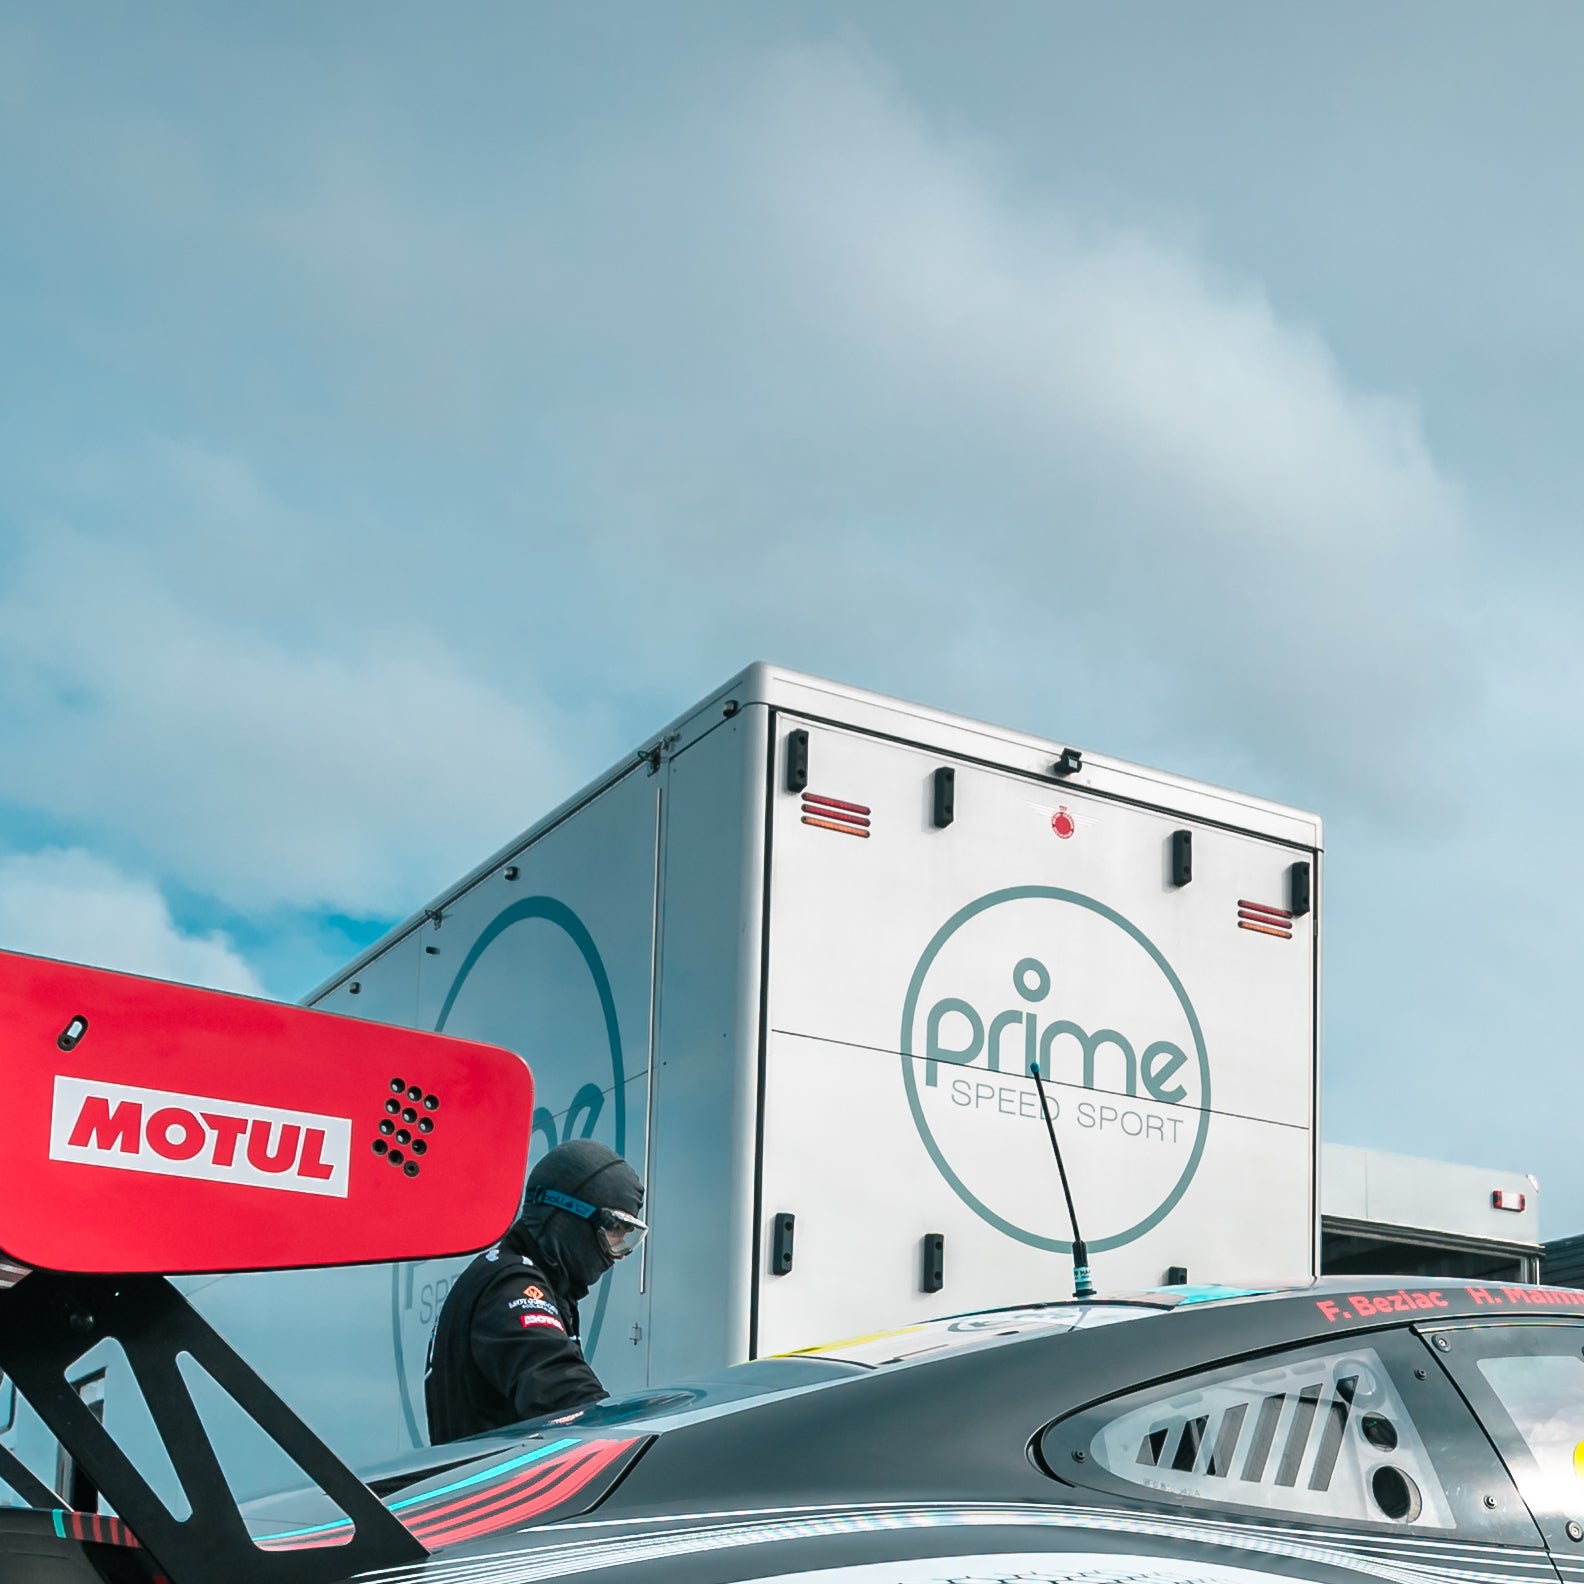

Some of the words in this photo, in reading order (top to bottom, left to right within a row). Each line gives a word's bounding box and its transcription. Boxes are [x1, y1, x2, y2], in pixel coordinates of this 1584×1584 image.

[925, 957, 1188, 1104] prime
[67, 1095, 335, 1180] MOTUL
[951, 1079, 1060, 1121] SPEED
[1077, 1102, 1184, 1143] SPORT
[1316, 1299, 1353, 1323] F.
